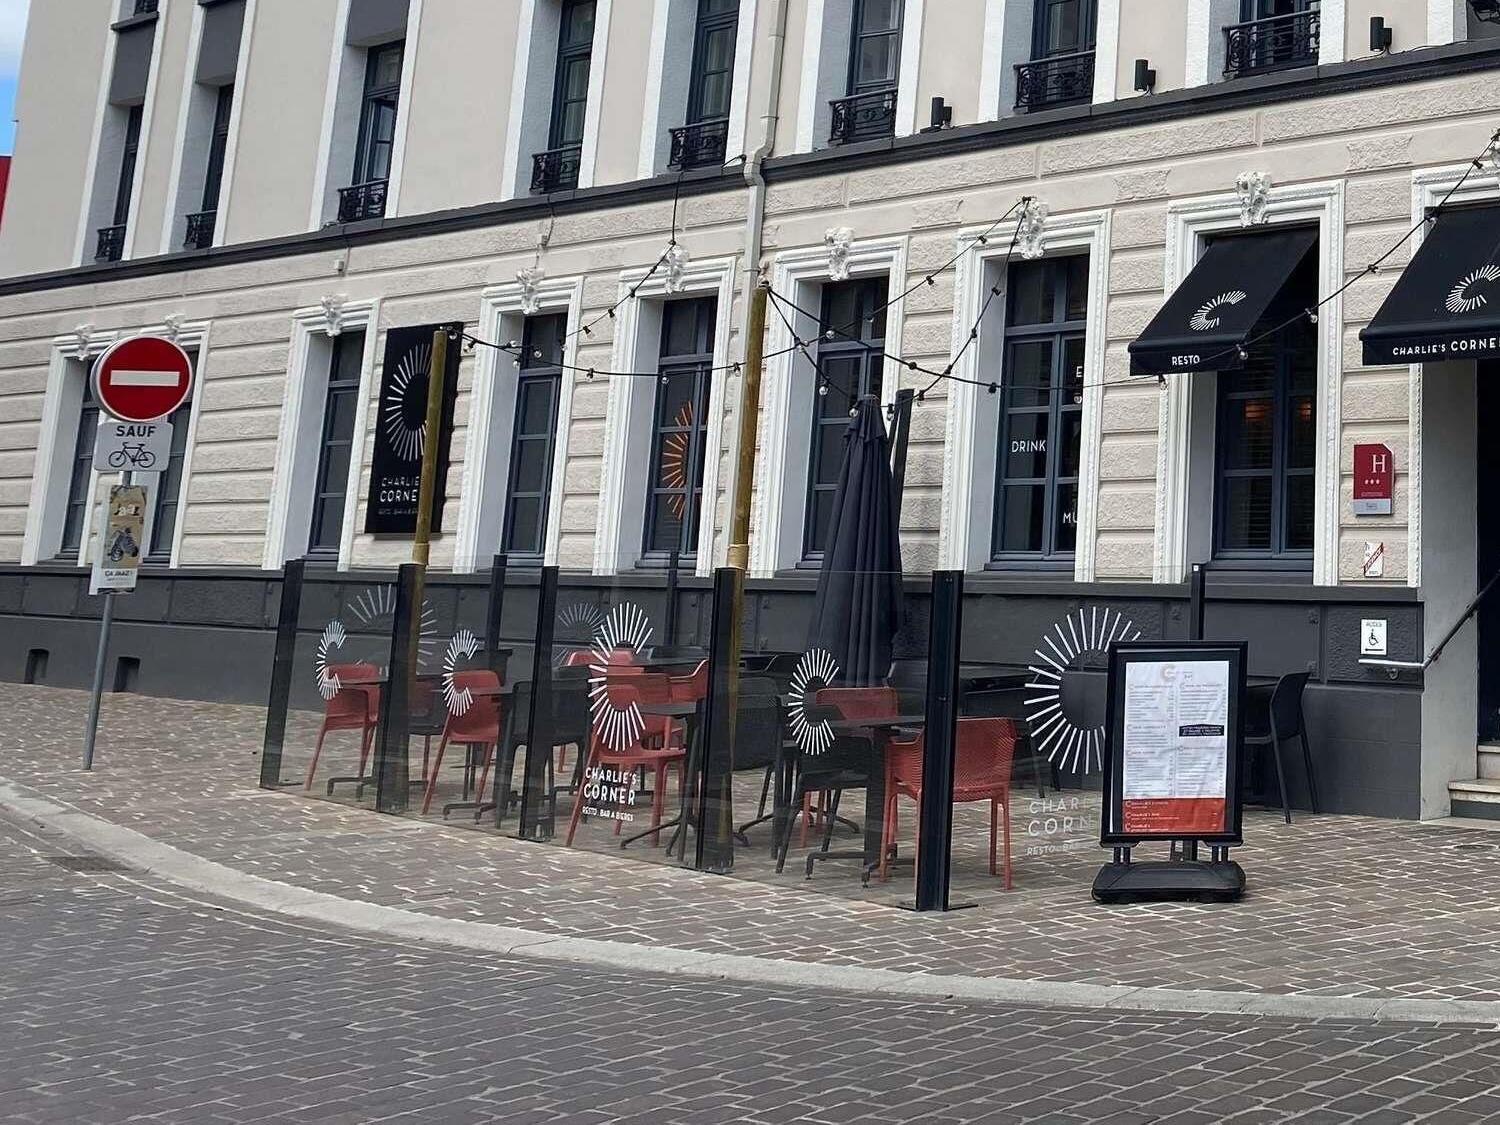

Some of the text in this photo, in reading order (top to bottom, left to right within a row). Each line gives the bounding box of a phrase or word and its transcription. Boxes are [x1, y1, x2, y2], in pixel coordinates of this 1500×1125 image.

[1392, 343, 1446, 356] CHARLIE'S
[1171, 354, 1201, 365] RESTO
[116, 425, 157, 437] SAUF
[1011, 439, 1047, 453] DRINK
[1371, 454, 1387, 474] H
[585, 766, 637, 785] CHARLIE'S
[583, 783, 635, 805] CORNER
